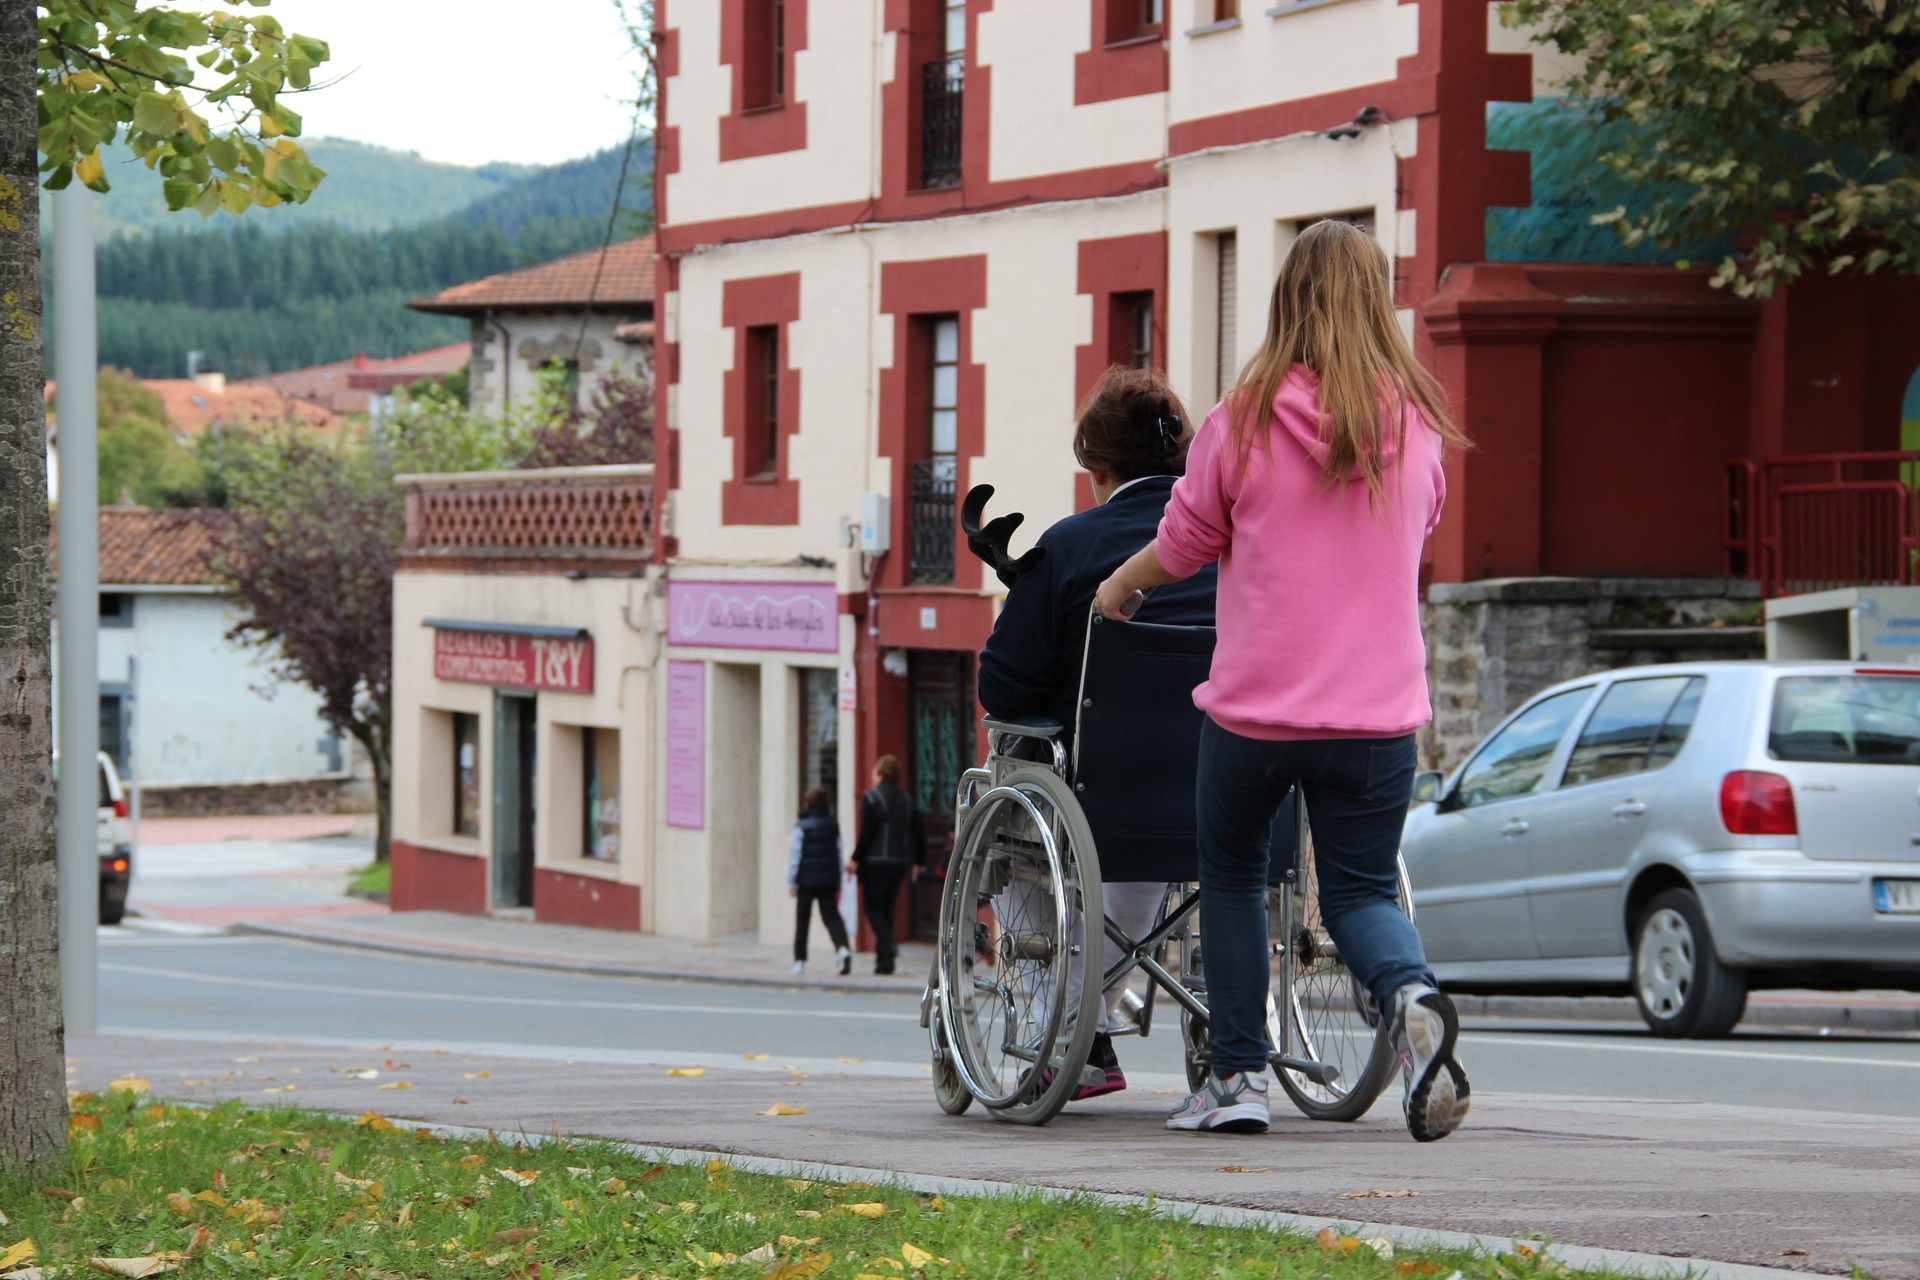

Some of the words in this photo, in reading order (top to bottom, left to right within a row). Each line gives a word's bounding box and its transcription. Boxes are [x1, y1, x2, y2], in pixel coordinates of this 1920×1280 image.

[437, 630, 506, 657] REGALOS
[510, 637, 518, 657] Y
[436, 653, 526, 684] COMPLEMENTOS
[530, 639, 586, 687] T&Y
